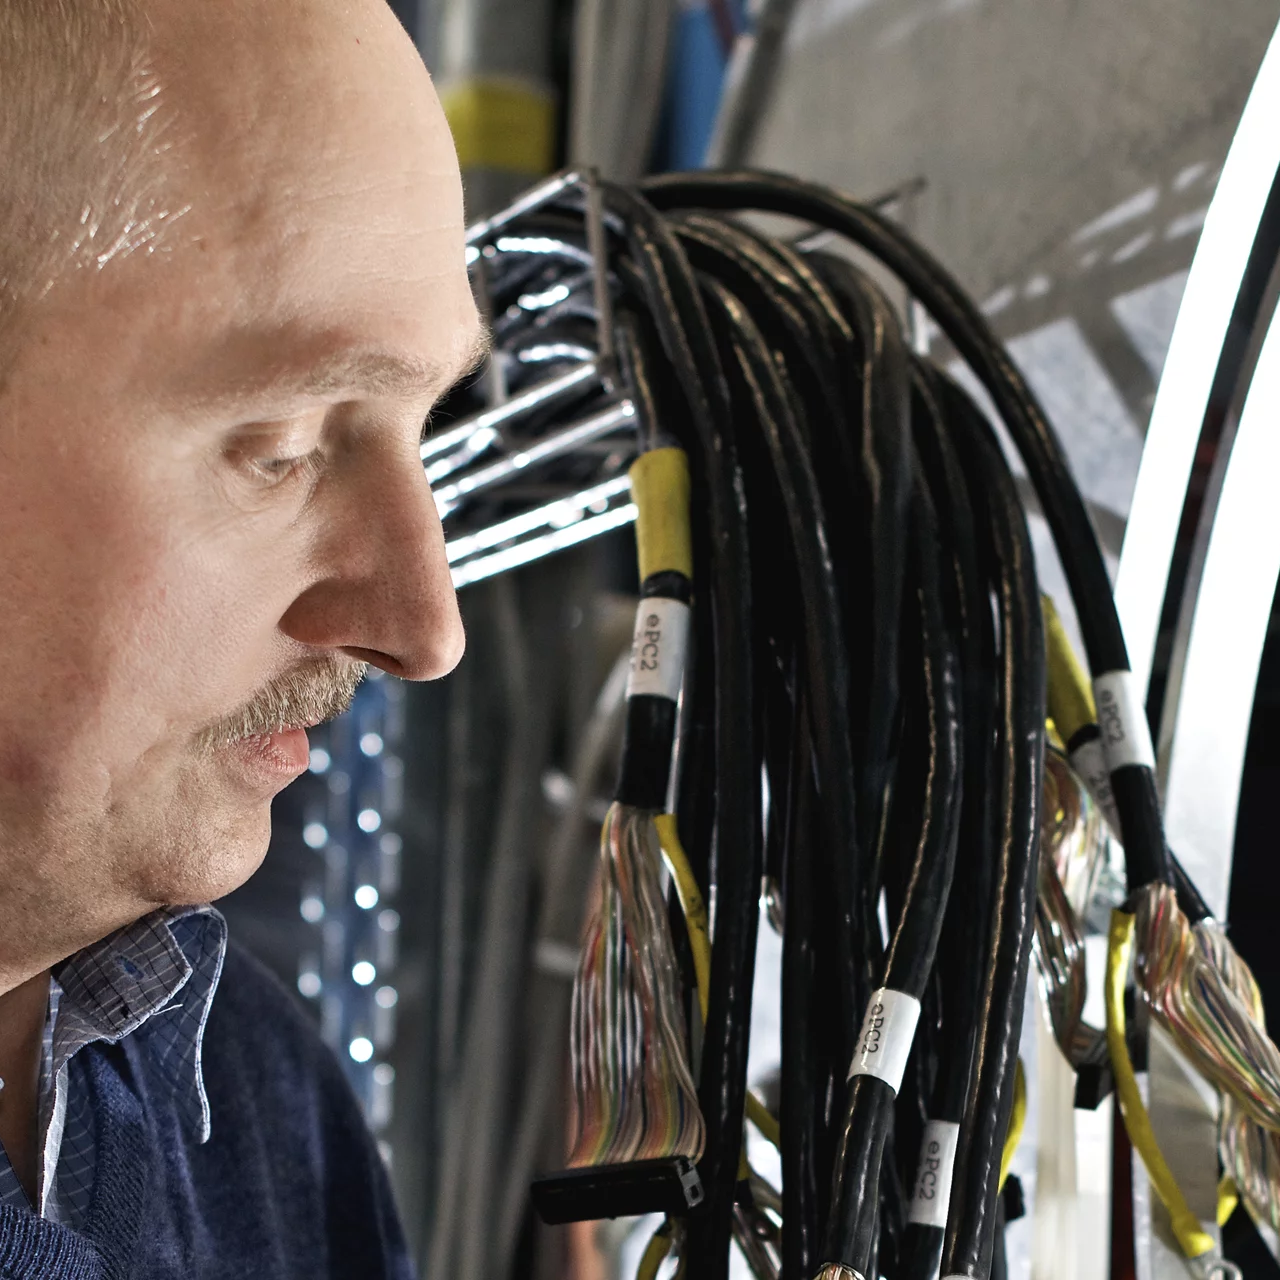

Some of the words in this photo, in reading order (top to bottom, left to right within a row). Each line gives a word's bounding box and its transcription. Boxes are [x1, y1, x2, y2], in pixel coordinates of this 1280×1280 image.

[640, 613, 660, 671] ePC2
[861, 1003, 884, 1054] ePC2
[920, 1141, 940, 1200] ePC2
